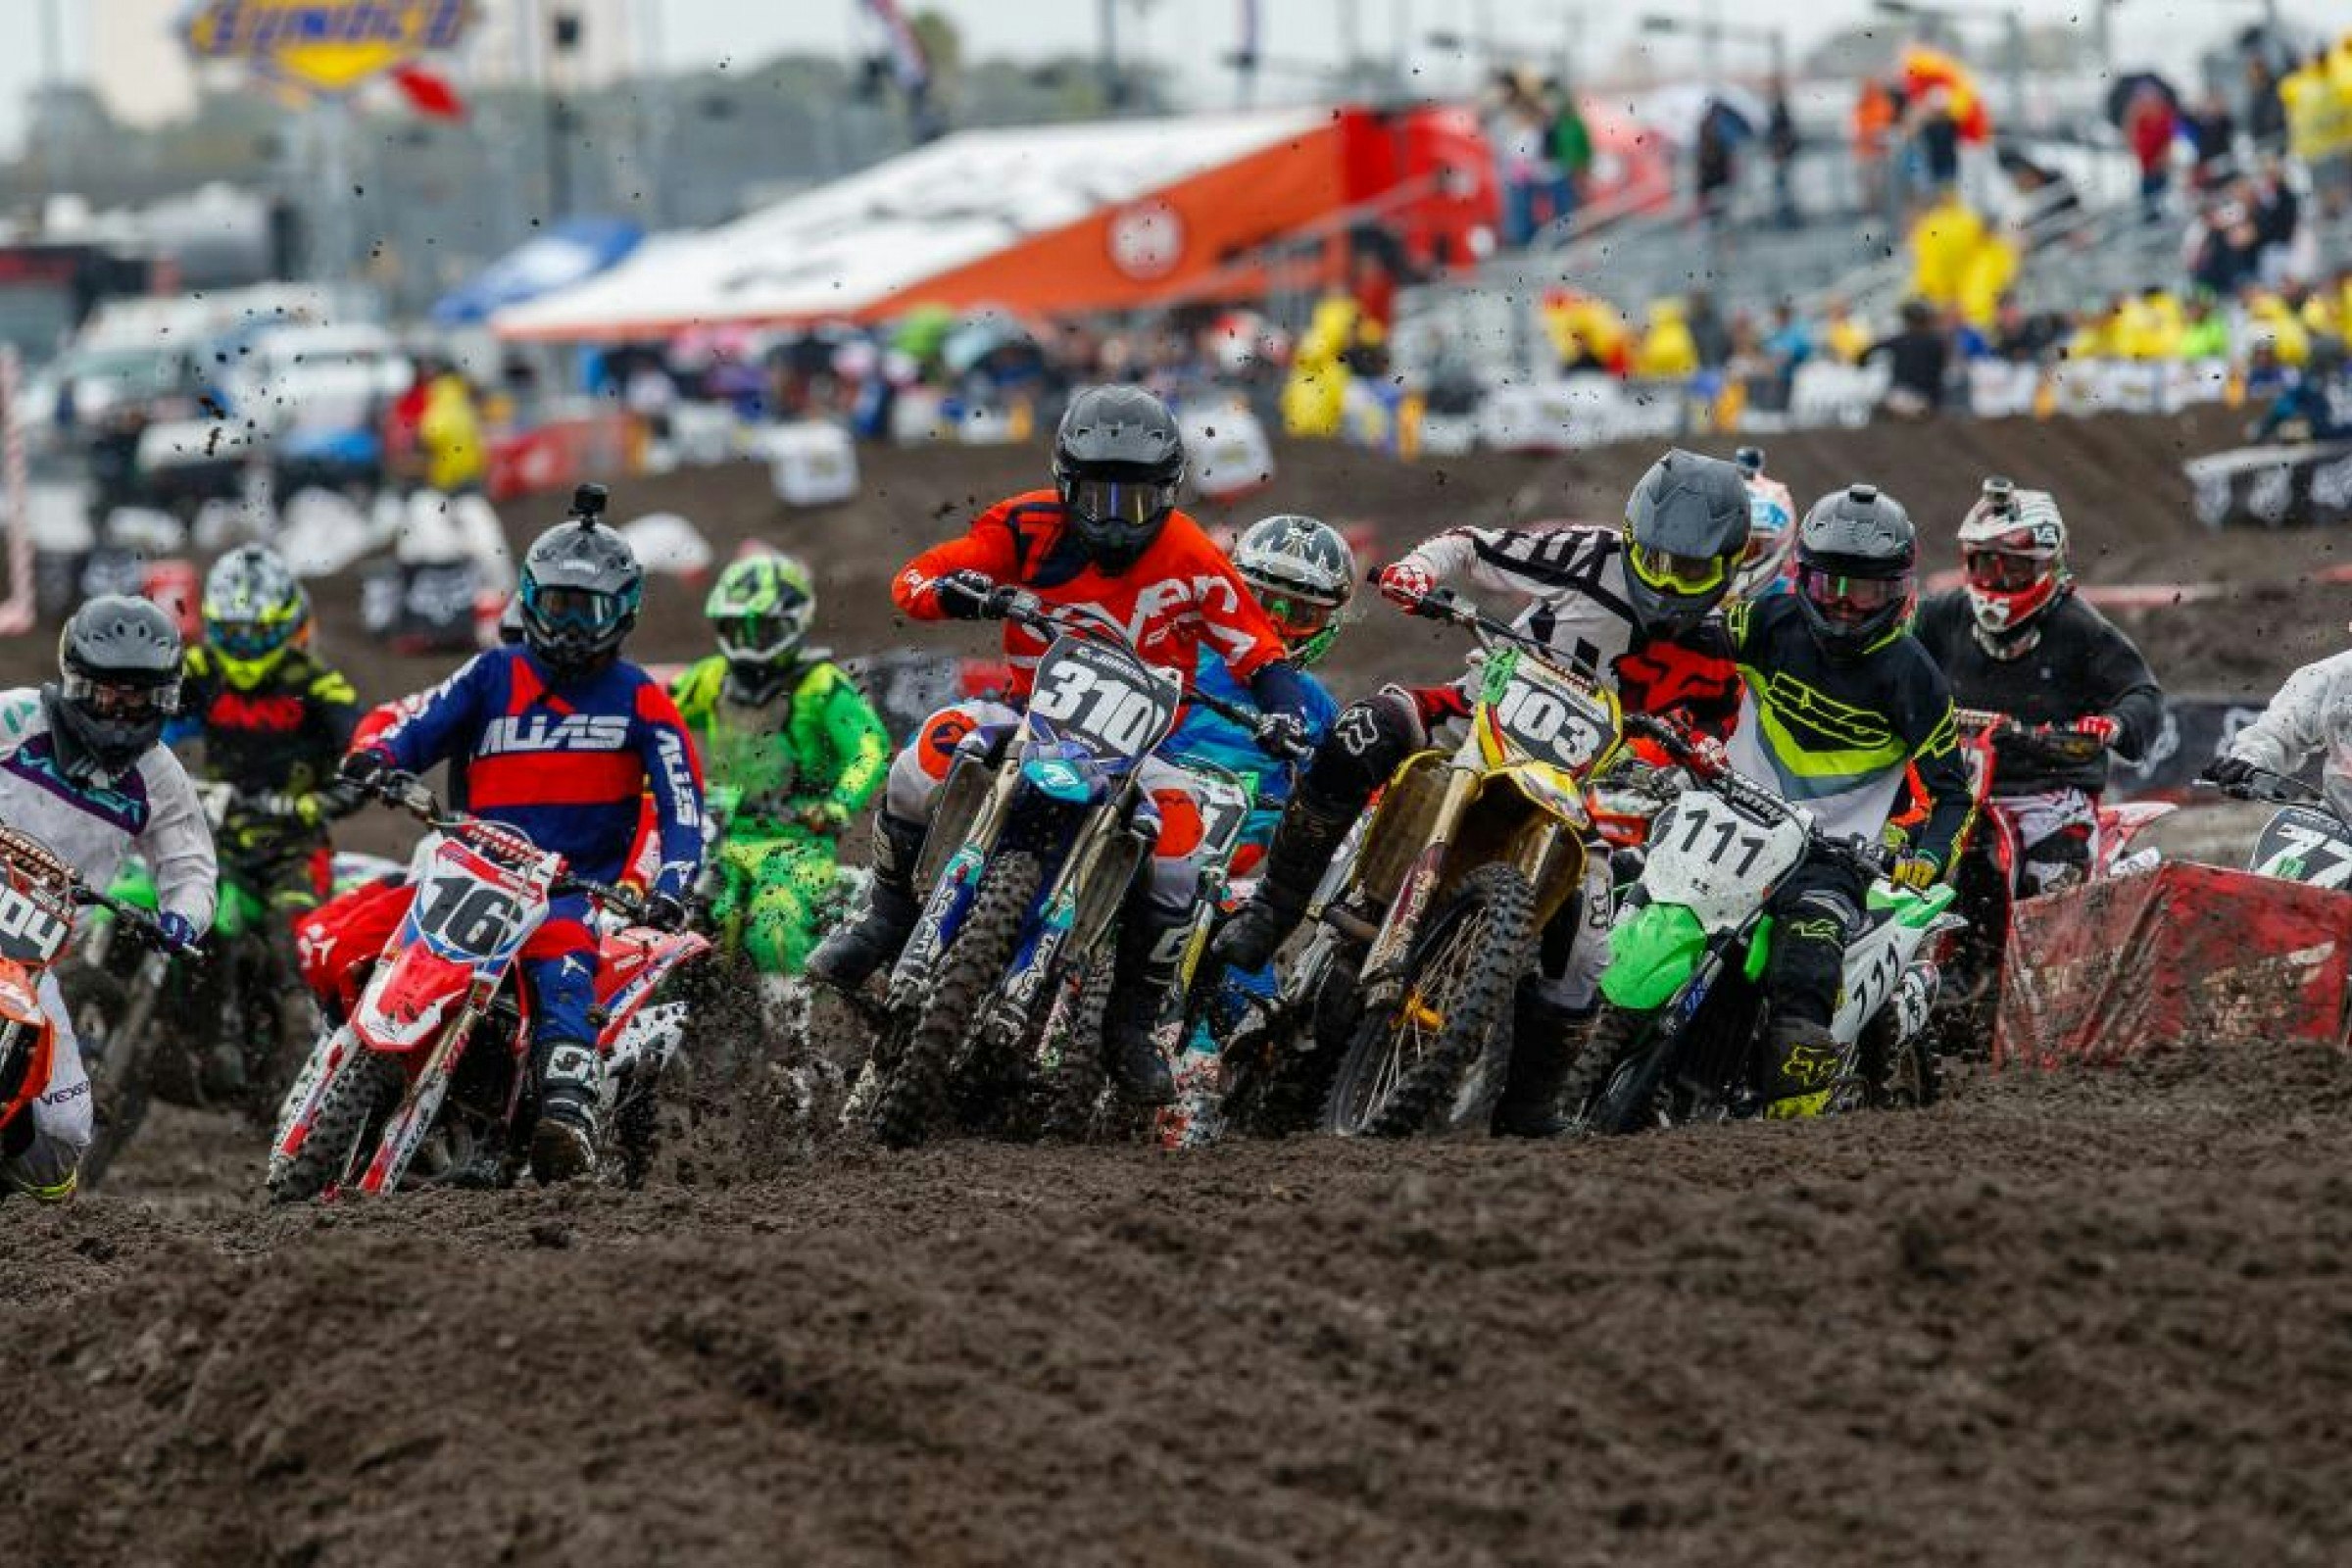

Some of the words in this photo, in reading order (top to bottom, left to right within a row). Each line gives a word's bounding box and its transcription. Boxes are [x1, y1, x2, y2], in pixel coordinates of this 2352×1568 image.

[1029, 660, 1166, 757] 310
[1497, 680, 1602, 767] 103
[1680, 808, 1765, 879] 111
[420, 877, 523, 956] 16
